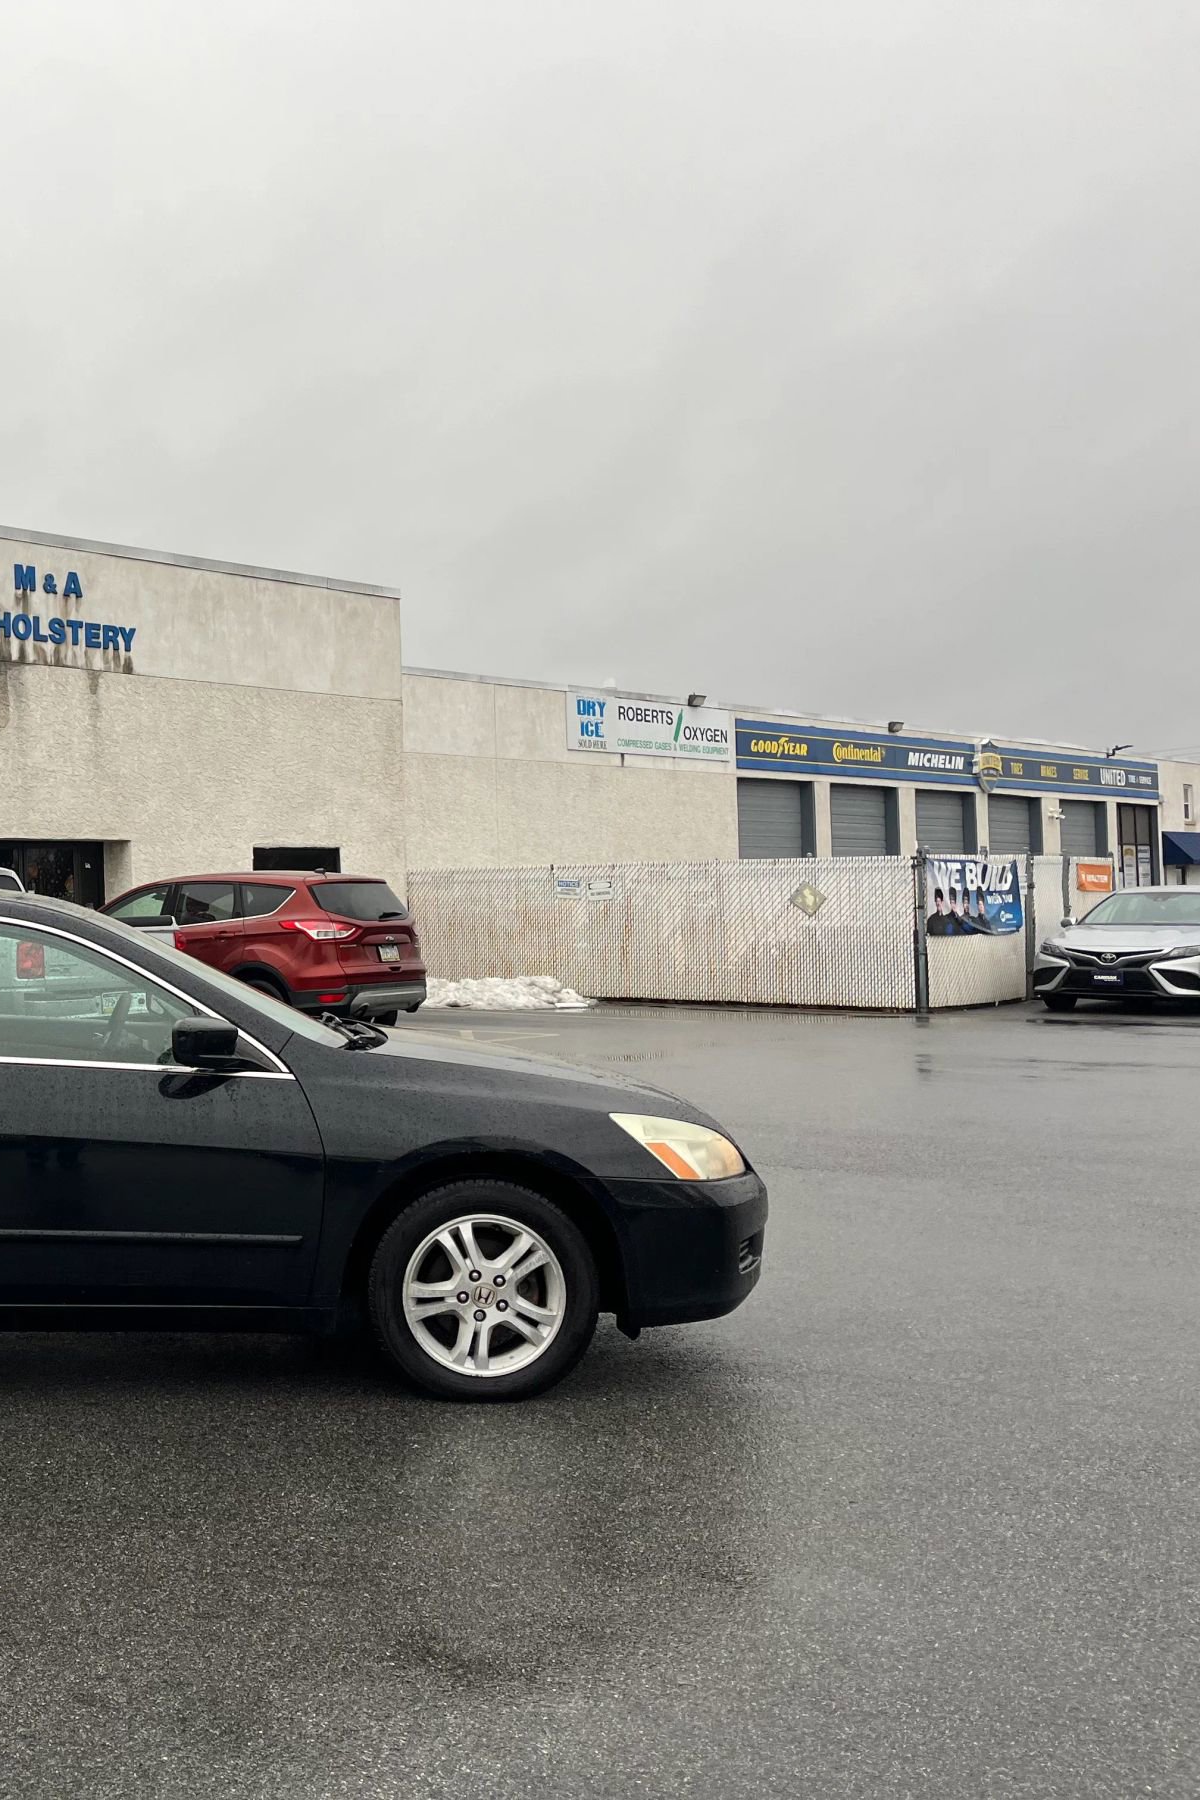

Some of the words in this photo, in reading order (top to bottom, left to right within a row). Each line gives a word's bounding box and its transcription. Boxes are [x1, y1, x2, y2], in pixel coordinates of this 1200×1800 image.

[14, 564, 36, 592] M
[42, 573, 58, 595] &
[63, 572, 83, 598] A
[576, 697, 606, 718] DRY
[617, 705, 674, 726] ROBERTS
[580, 720, 605, 738] ICE
[683, 725, 729, 744] OXYGEN
[578, 739, 592, 749] SOLD
[593, 740, 607, 750] HERE
[617, 738, 653, 749] COMPRESSED
[654, 742, 672, 752] GASES
[679, 744, 701, 754] WELDING
[702, 745, 729, 756] EQUIPMENT
[751, 736, 808, 758] GOODYEAR
[833, 741, 882, 763] Continental
[908, 751, 964, 771] MICHELIN
[1100, 767, 1126, 786] UNITED
[933, 861, 962, 891] WE
[965, 861, 1013, 892] BUILD
